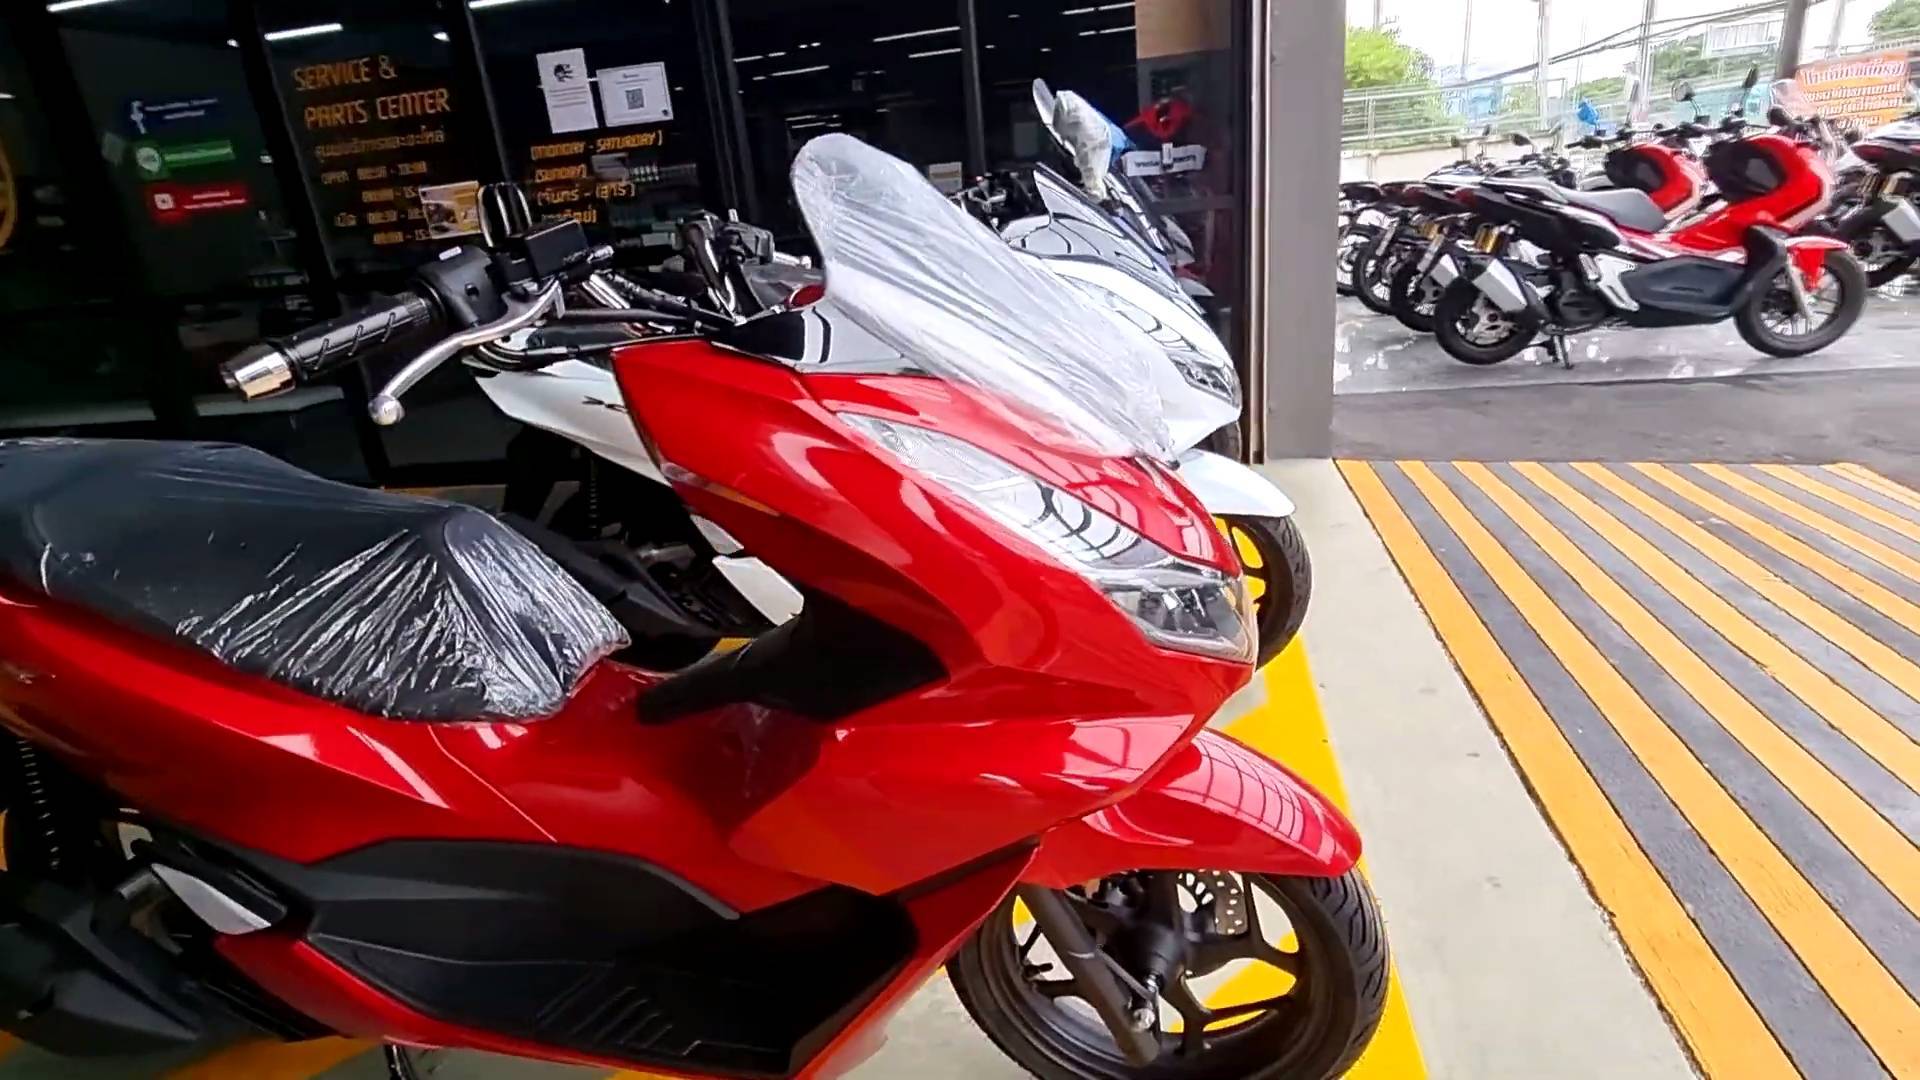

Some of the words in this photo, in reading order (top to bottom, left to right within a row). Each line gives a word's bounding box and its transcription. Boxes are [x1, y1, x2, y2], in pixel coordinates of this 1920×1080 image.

[294, 57, 371, 91] SERVICE
[378, 55, 398, 79] &
[304, 100, 368, 129] PARTS
[376, 88, 451, 120] CENTER
